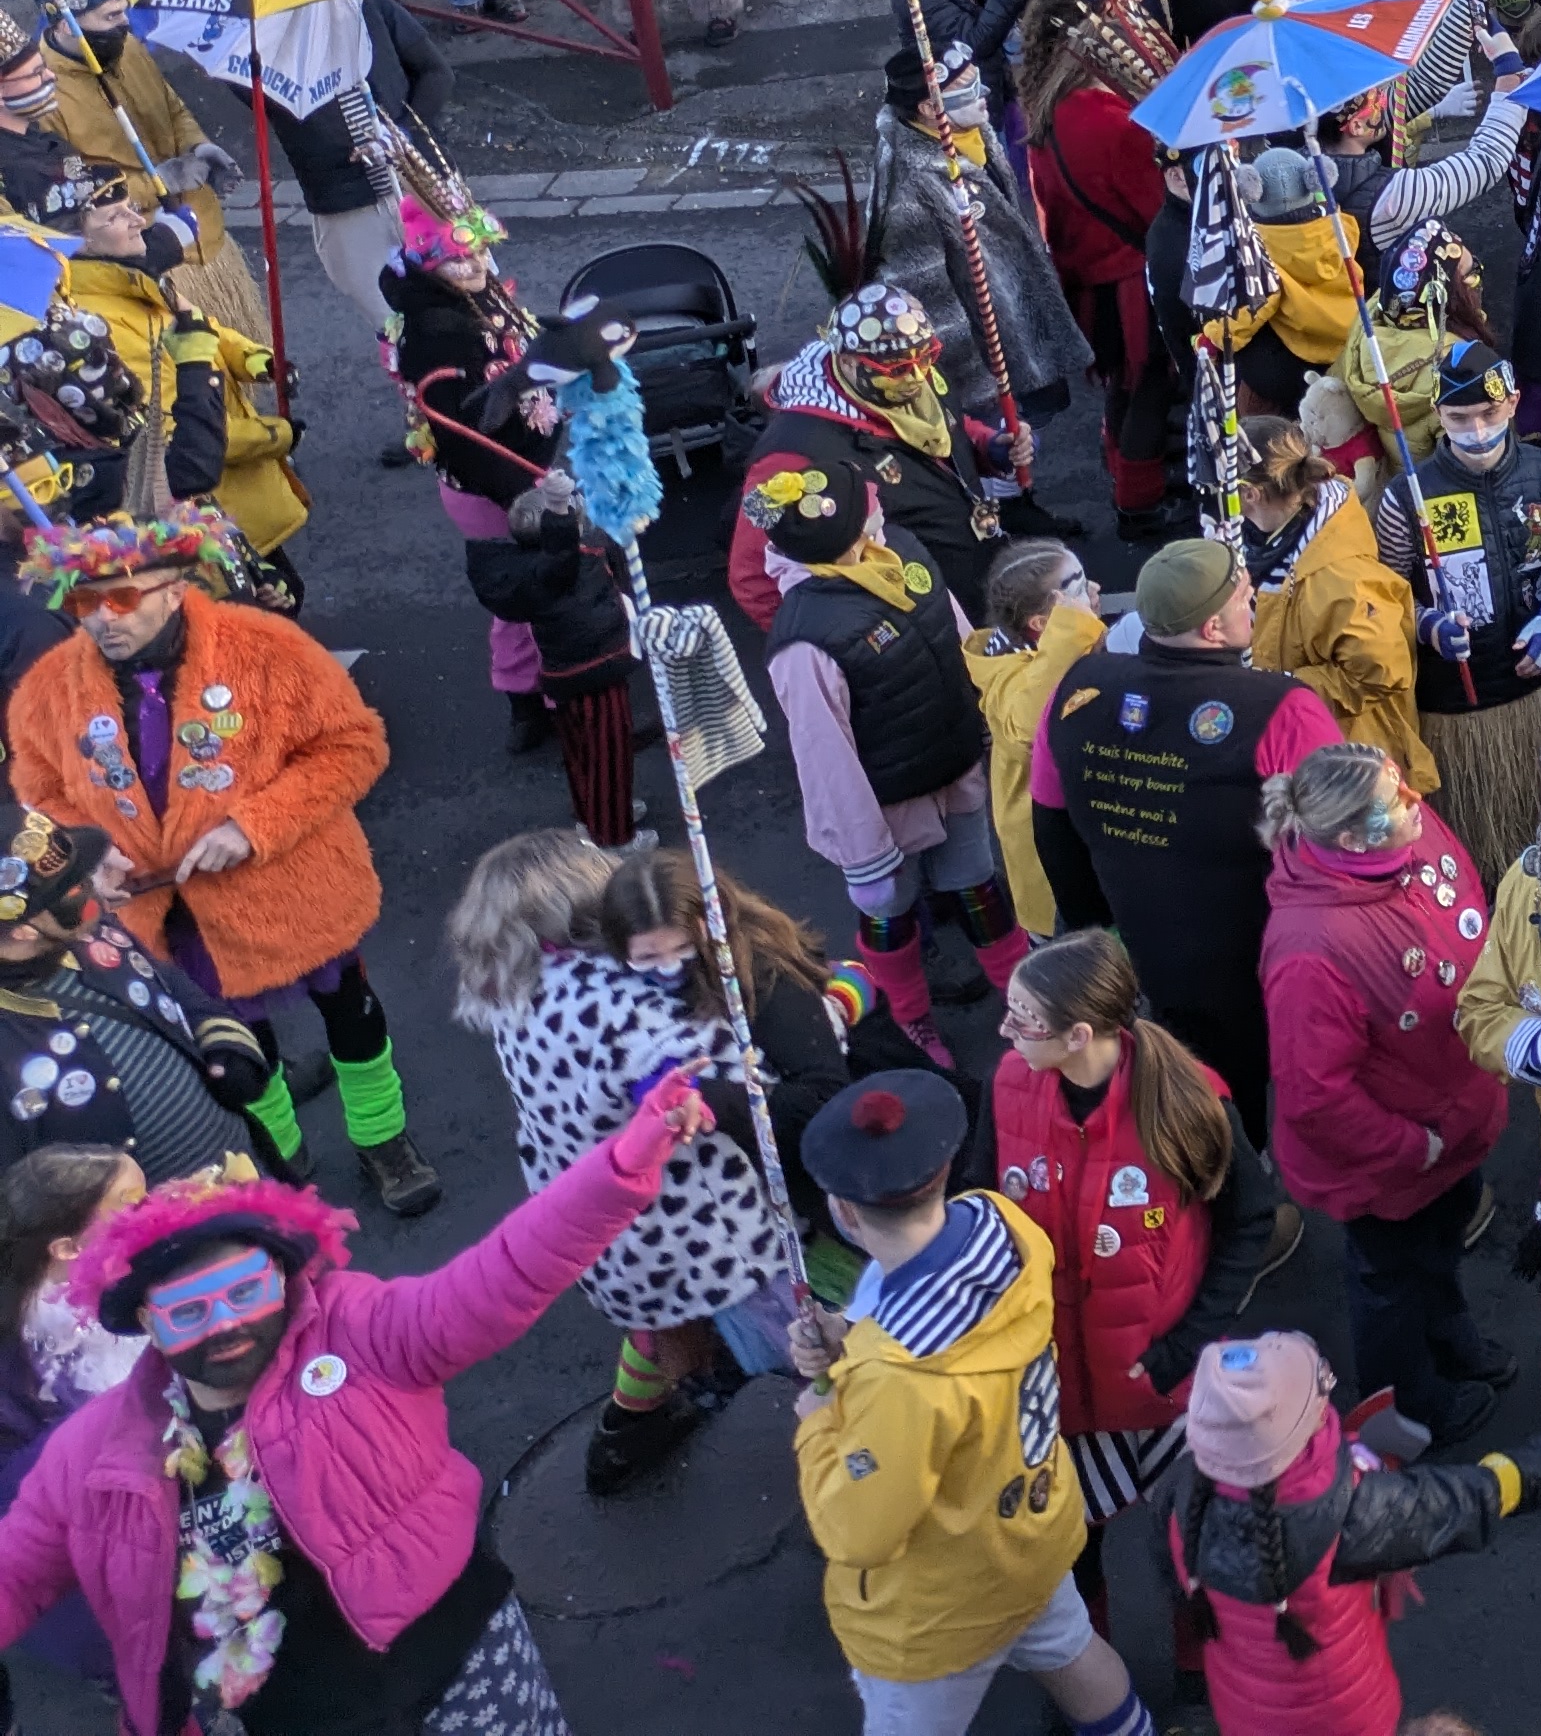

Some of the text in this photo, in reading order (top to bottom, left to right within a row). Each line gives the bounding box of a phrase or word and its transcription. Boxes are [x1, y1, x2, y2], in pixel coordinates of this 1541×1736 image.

[1082, 740, 1095, 754] Je
[1099, 744, 1120, 759] suis
[1083, 765, 1185, 794] je suis trop bourré
[1090, 799, 1177, 824] ramène moi à
